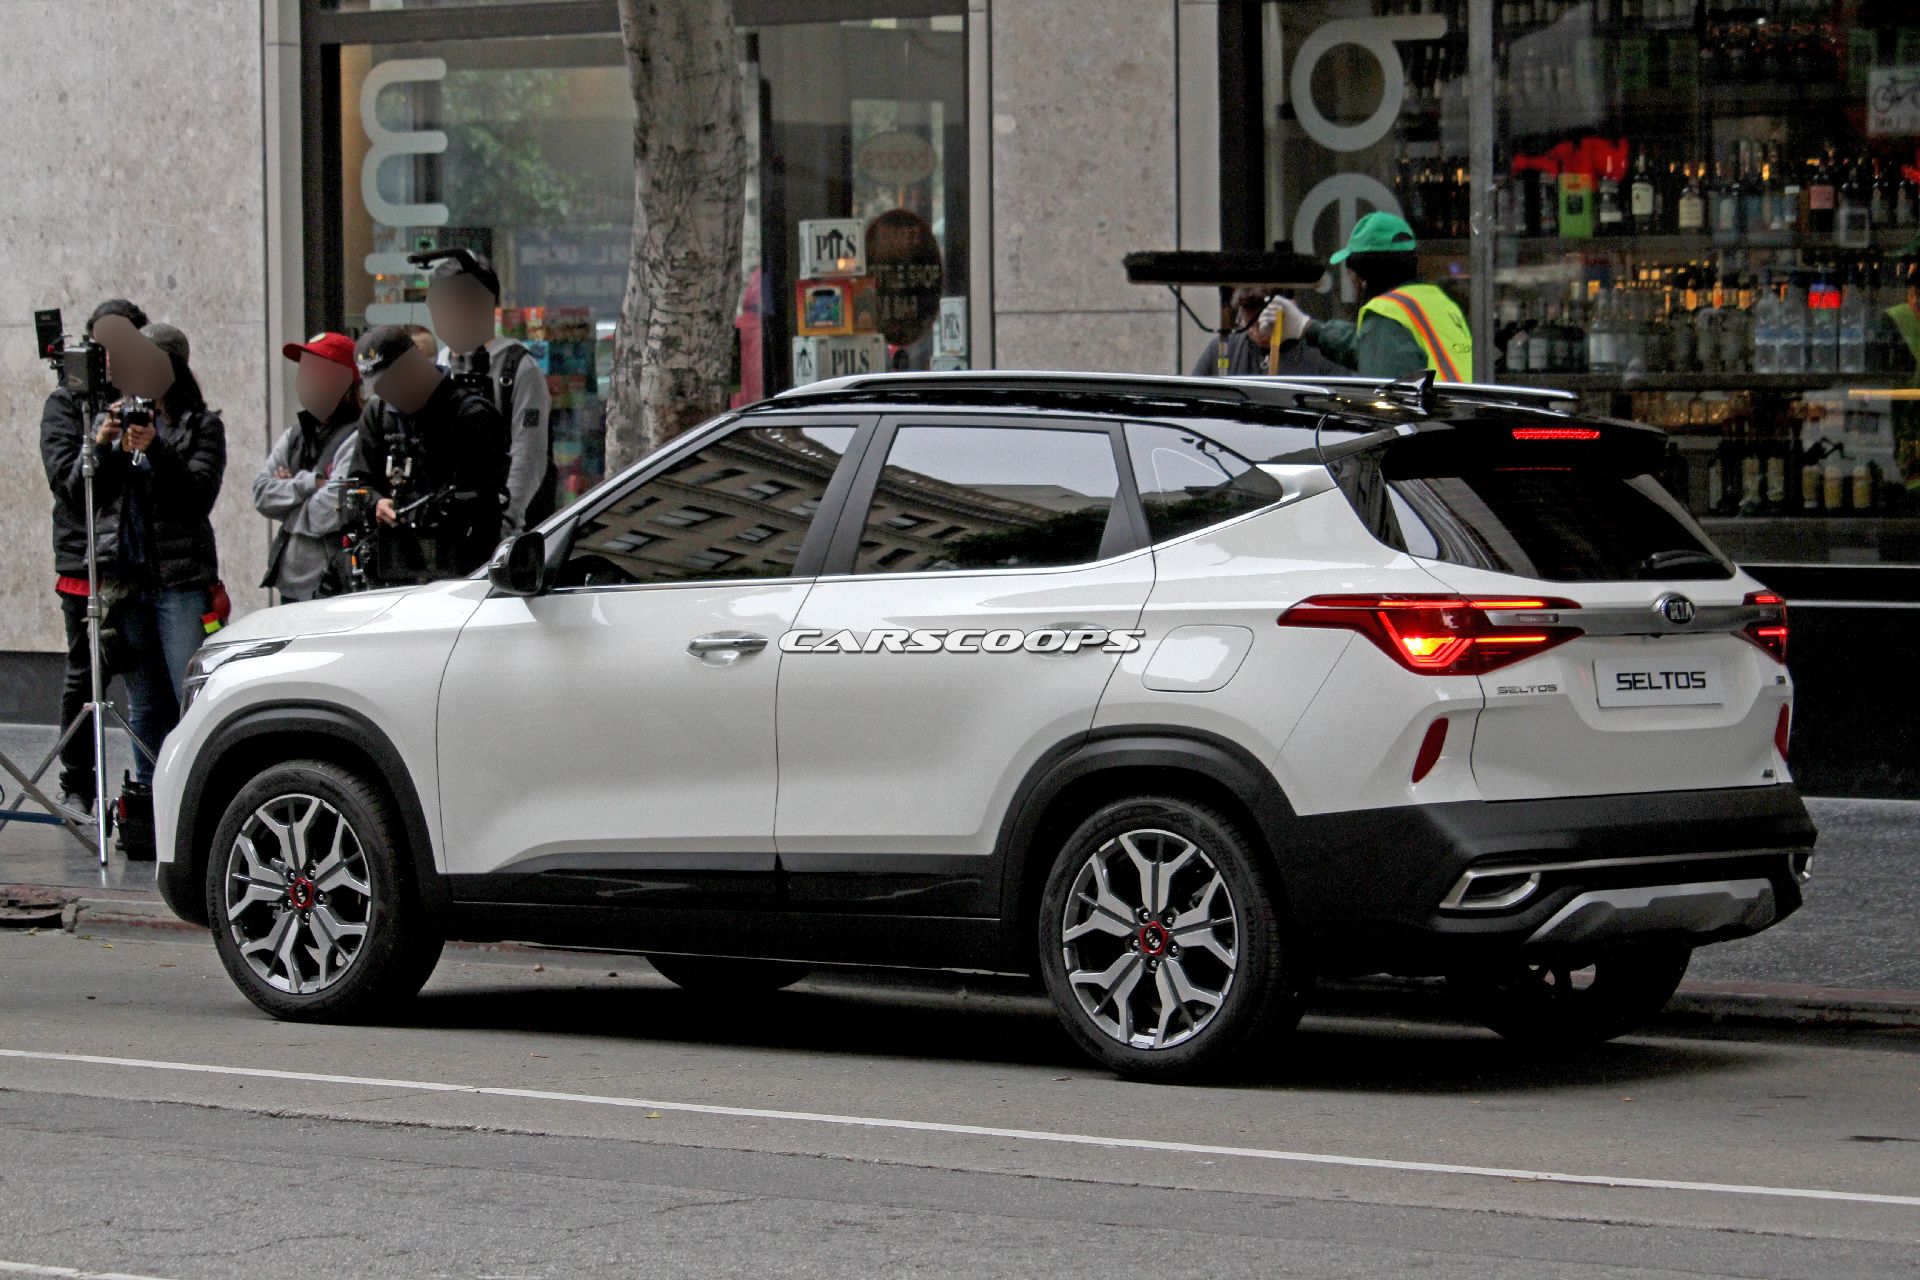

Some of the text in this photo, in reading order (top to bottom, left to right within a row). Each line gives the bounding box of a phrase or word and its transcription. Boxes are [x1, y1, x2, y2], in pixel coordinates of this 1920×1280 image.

[1668, 601, 1694, 620] KIA
[1497, 684, 1558, 696] SELTOS
[1616, 671, 1707, 691] SELTOS
